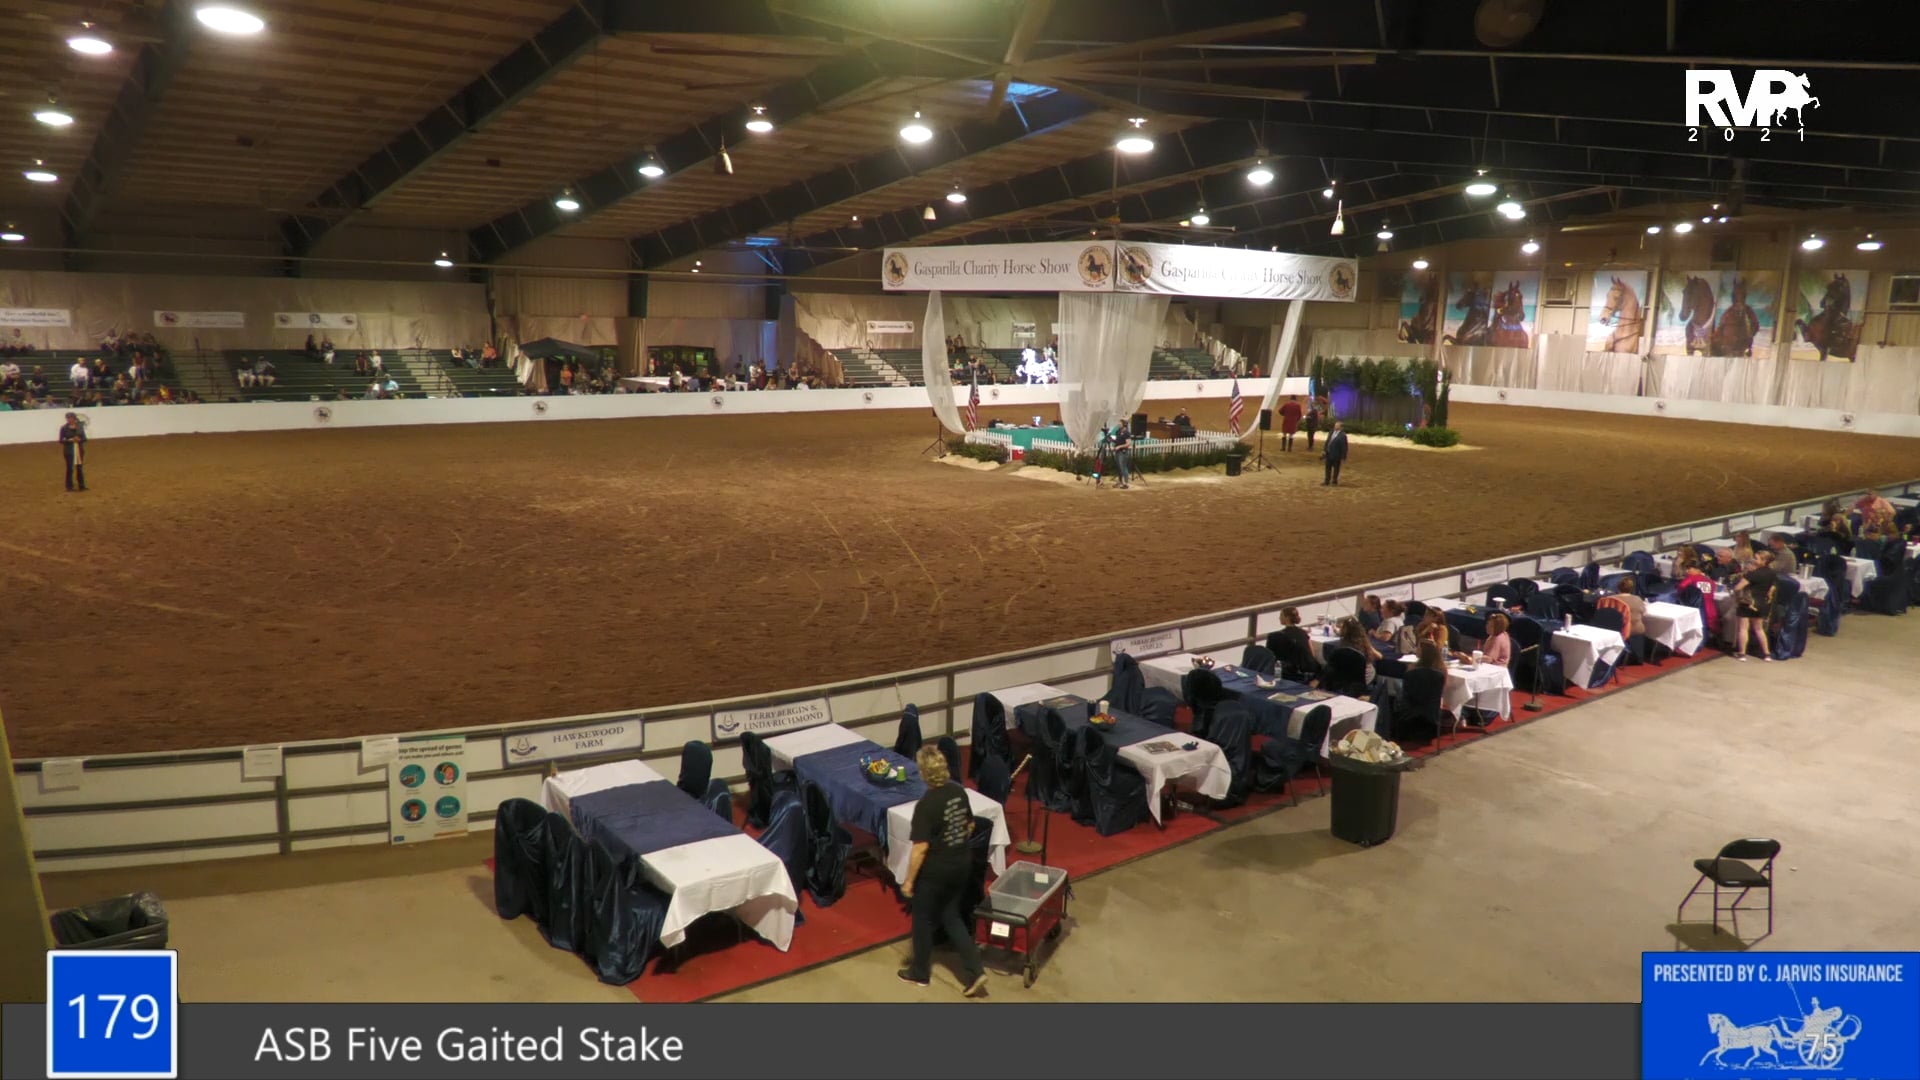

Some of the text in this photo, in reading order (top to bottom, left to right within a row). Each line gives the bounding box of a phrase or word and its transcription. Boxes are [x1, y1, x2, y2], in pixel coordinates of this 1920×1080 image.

[914, 257, 1071, 279] Gasparilla Charity Horse Show
[1262, 266, 1294, 284] Horse
[1295, 269, 1322, 285] Show
[743, 711, 823, 730] LINDA RICHMOND
[749, 711, 774, 721] TERRY
[776, 705, 809, 717] BERGIN
[553, 726, 624, 743] HAWKEWOOD
[575, 738, 604, 750] FARM
